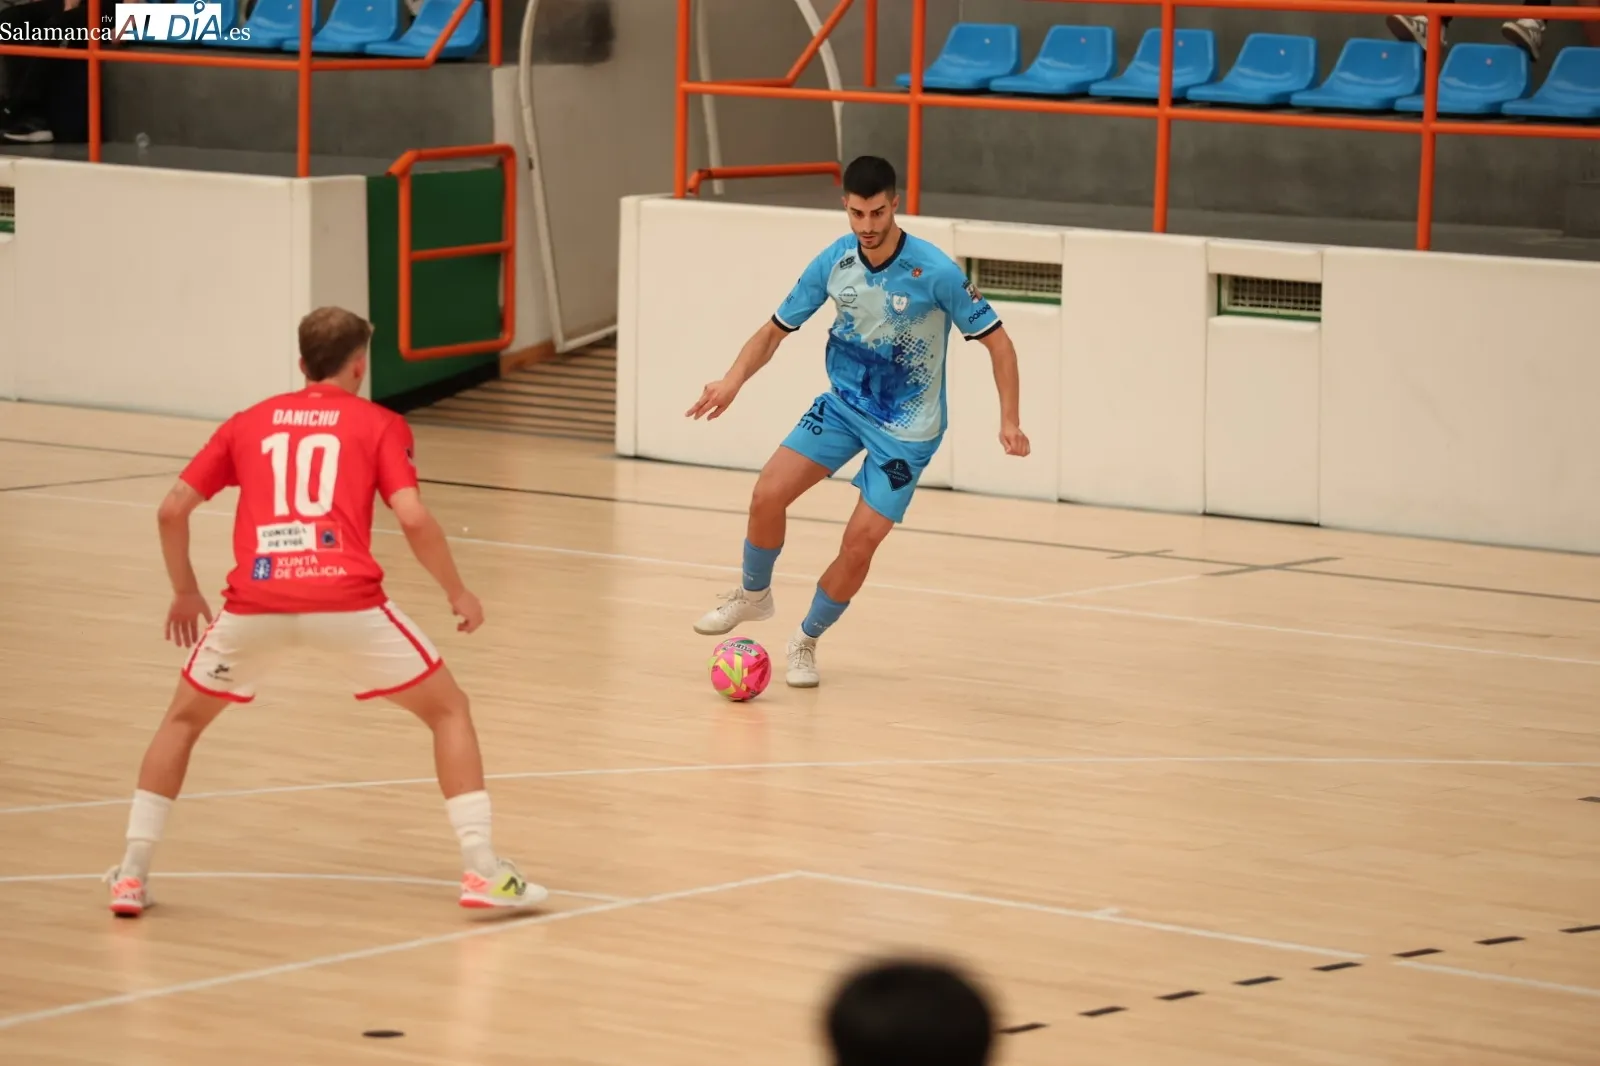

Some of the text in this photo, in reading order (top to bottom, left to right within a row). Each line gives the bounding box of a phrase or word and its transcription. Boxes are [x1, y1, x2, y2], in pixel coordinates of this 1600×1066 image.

[272, 408, 340, 426] DANICHU
[261, 431, 341, 517] 10
[277, 554, 319, 567] XUNTA
[274, 566, 347, 579] DE GALICIA
